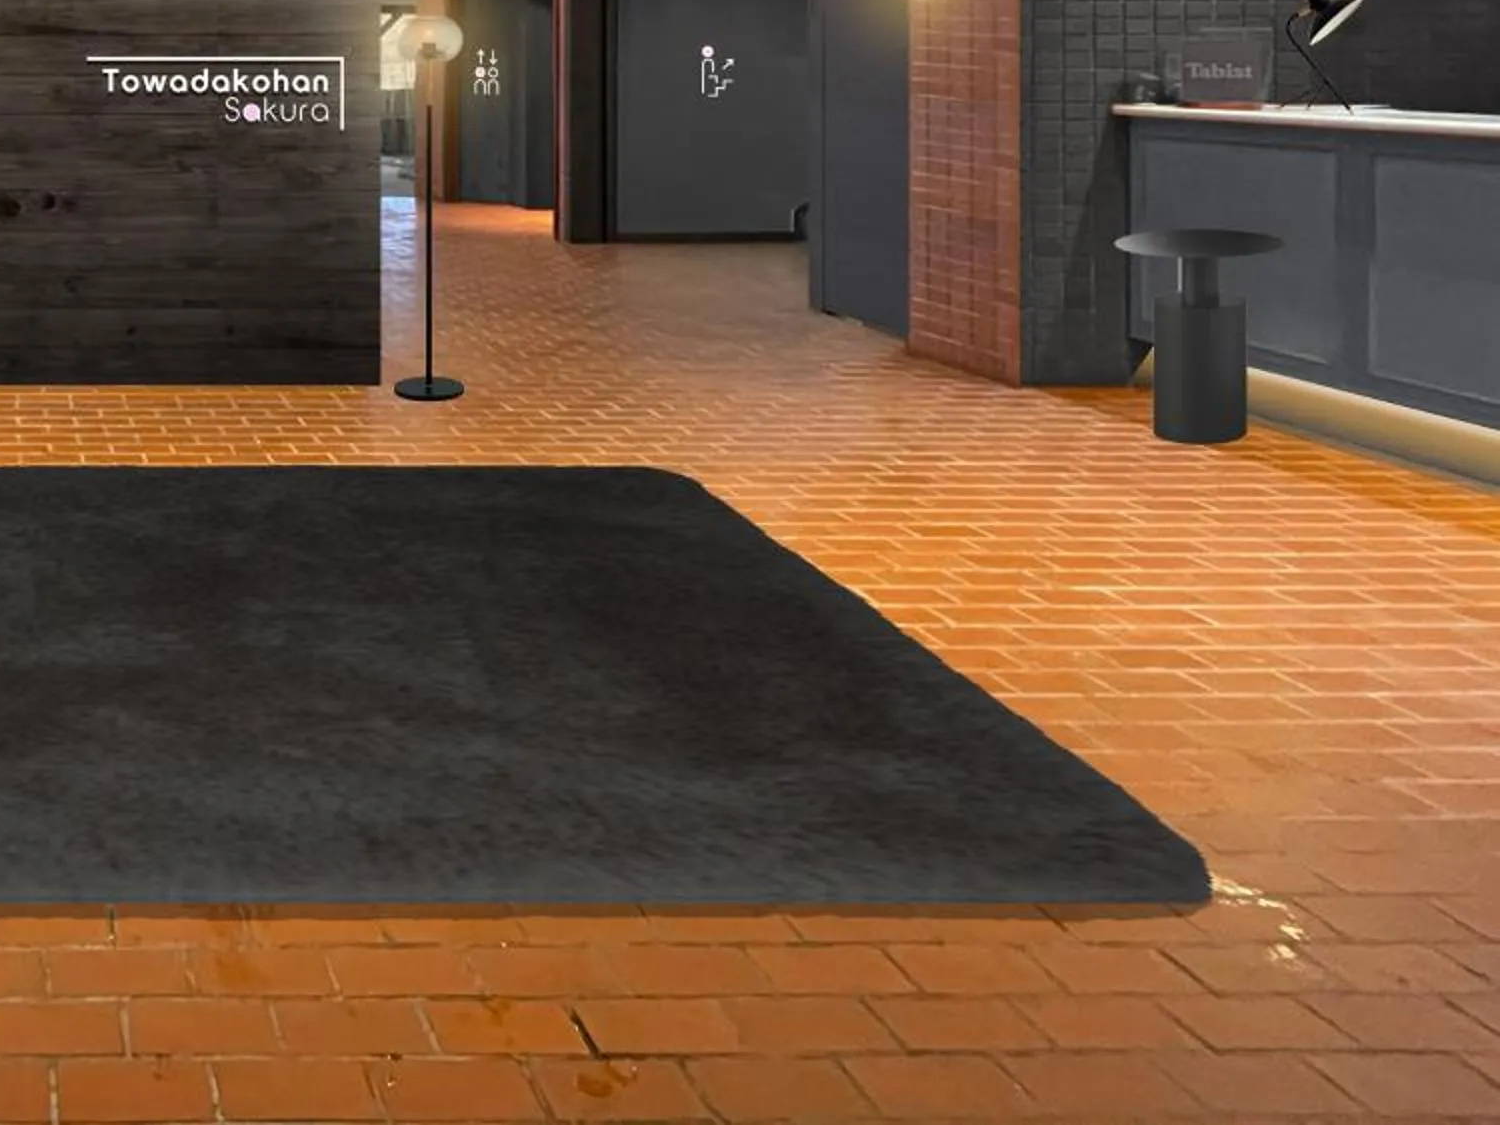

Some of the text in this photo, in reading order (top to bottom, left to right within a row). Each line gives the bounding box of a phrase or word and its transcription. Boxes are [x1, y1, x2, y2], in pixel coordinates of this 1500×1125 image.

[101, 67, 330, 94] Towadakohan
[1184, 61, 1253, 80] Tabist
[224, 96, 330, 123] Sakura
